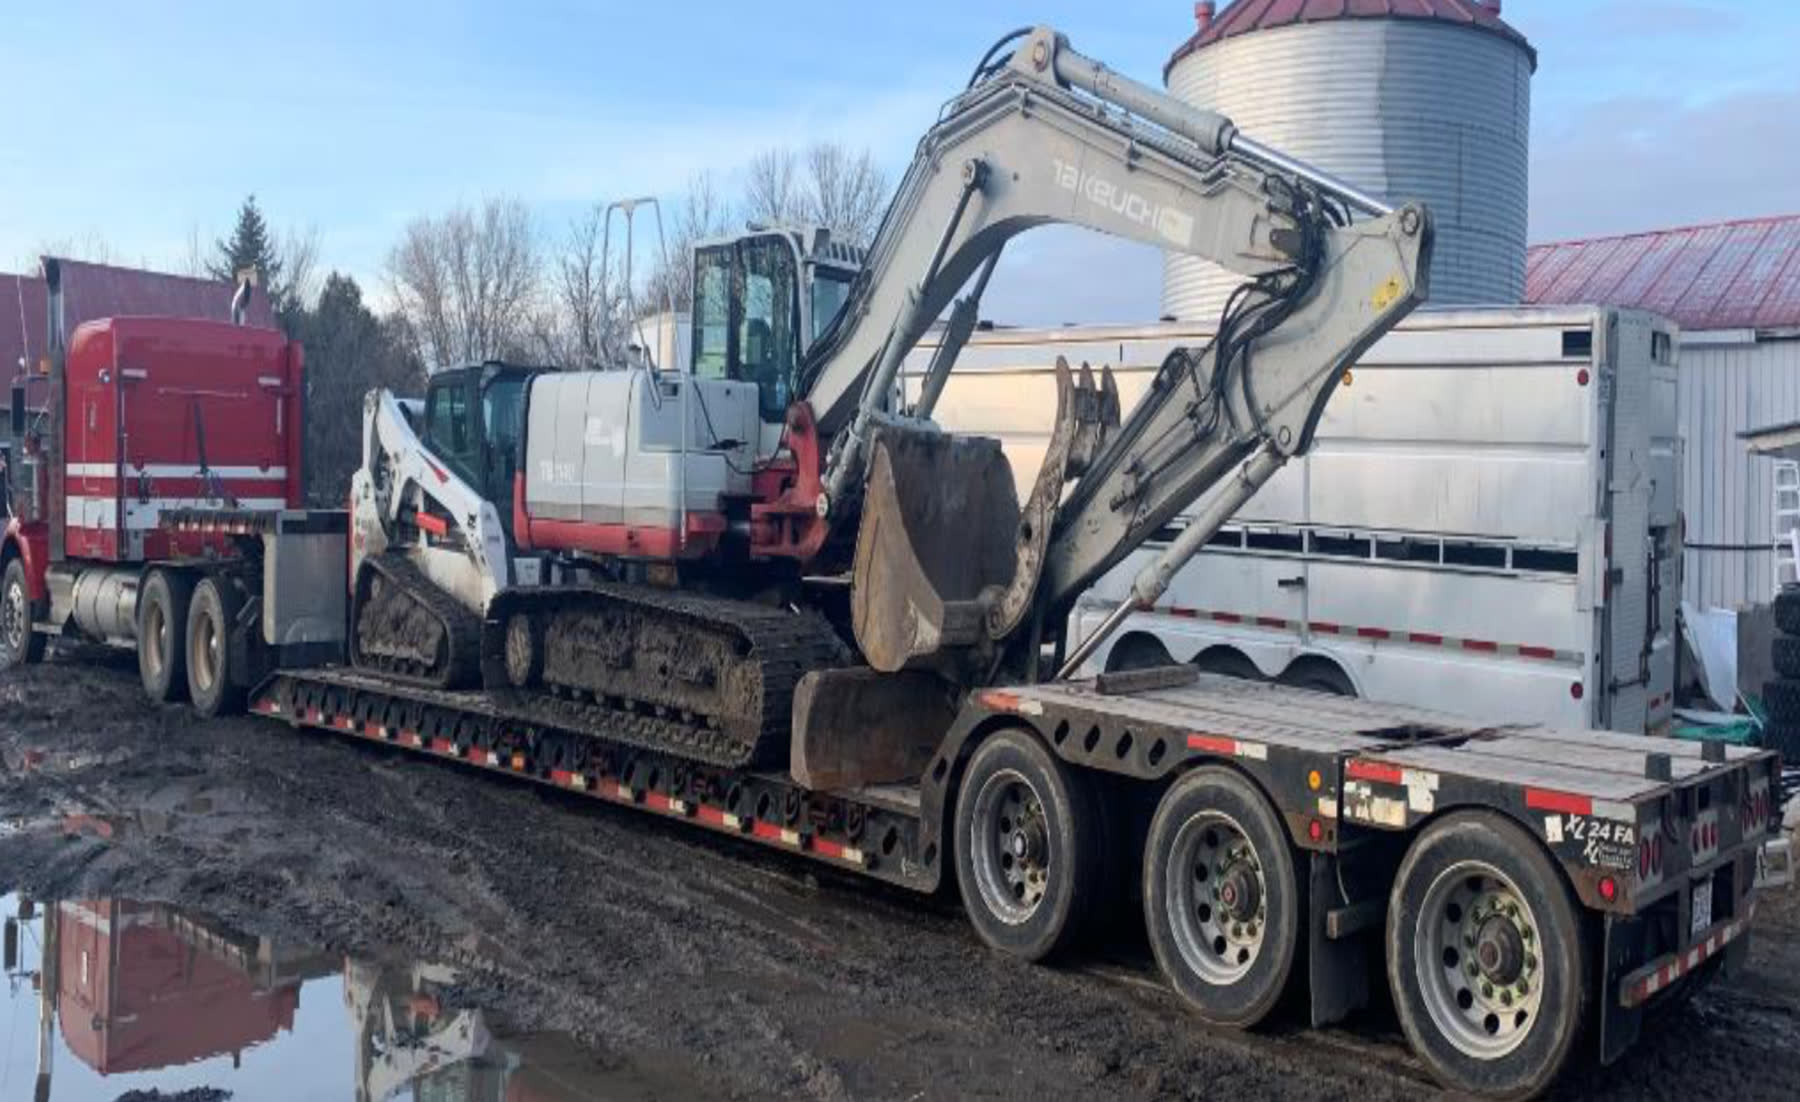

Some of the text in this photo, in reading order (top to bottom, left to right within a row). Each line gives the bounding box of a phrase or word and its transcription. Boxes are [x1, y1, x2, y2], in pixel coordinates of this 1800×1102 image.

[1564, 813, 1635, 845] XL 24 FA
[1583, 838, 1599, 864] XL
